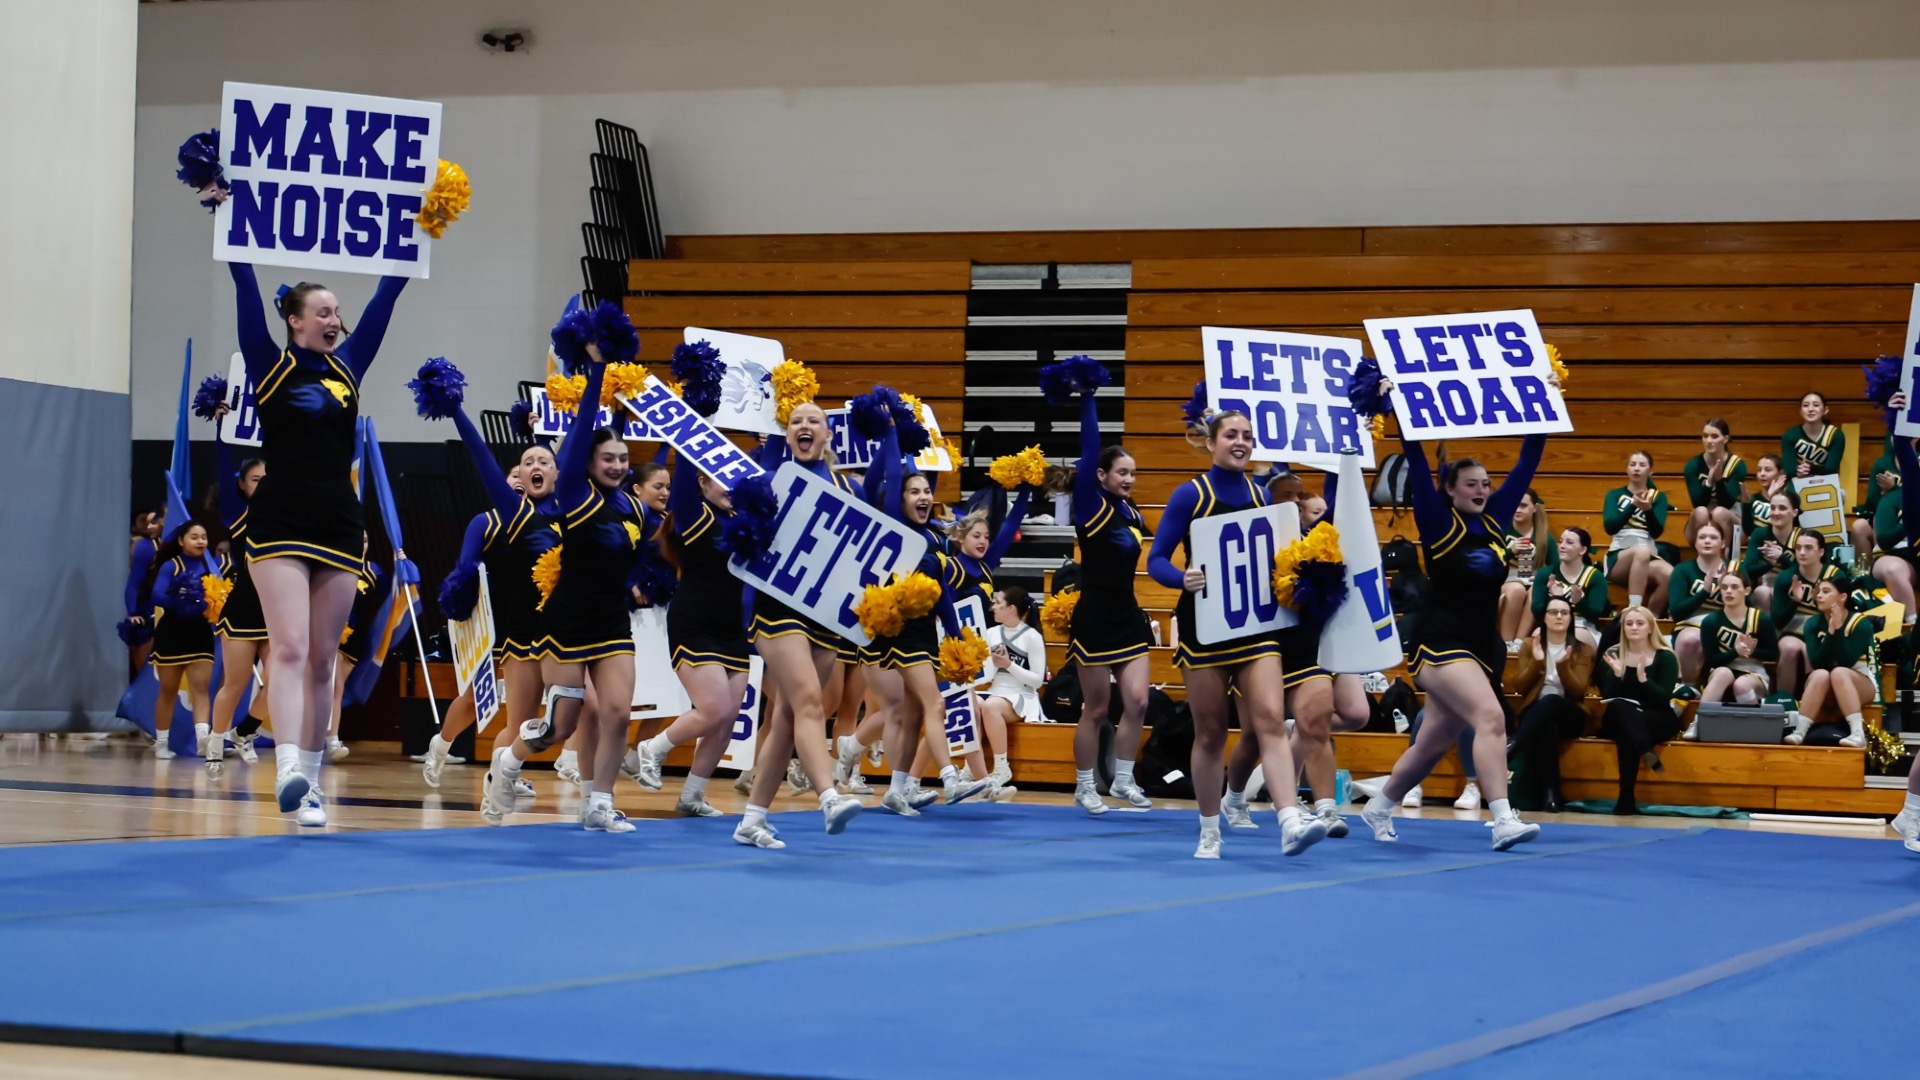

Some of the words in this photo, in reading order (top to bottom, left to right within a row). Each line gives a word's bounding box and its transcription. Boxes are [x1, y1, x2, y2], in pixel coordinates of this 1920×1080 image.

[230, 98, 430, 184] MAKE
[227, 178, 422, 262] NOISE
[1217, 339, 1352, 398] LET'S
[1381, 321, 1535, 374] LET'S
[626, 384, 760, 492] EFENSE
[1397, 375, 1559, 428] ROAR
[731, 475, 904, 629] LET'S
[1219, 516, 1279, 630] GO
